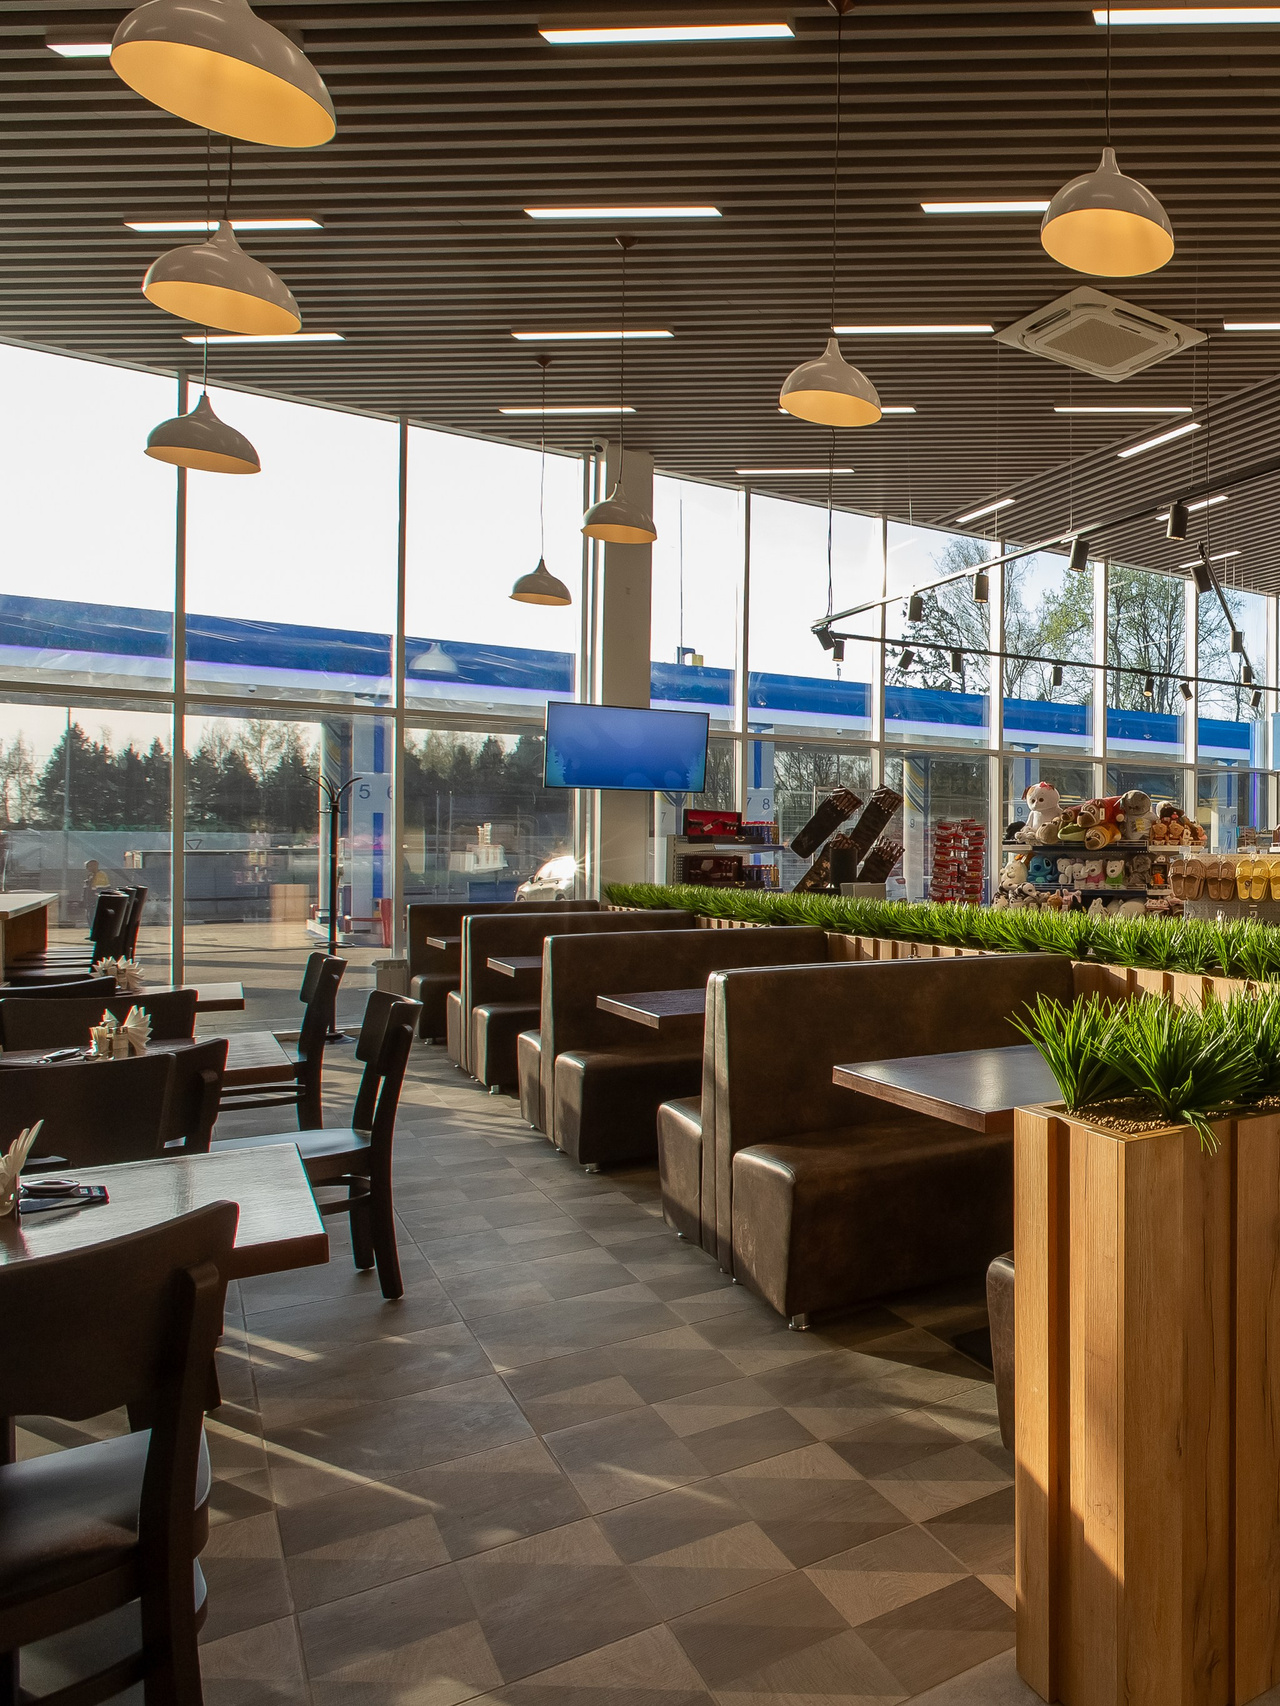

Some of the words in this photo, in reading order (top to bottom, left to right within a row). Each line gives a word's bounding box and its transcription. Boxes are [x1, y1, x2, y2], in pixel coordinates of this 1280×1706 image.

[359, 784, 371, 799] 5
[762, 797, 771, 810] 8
[1016, 806, 1023, 817] 9
